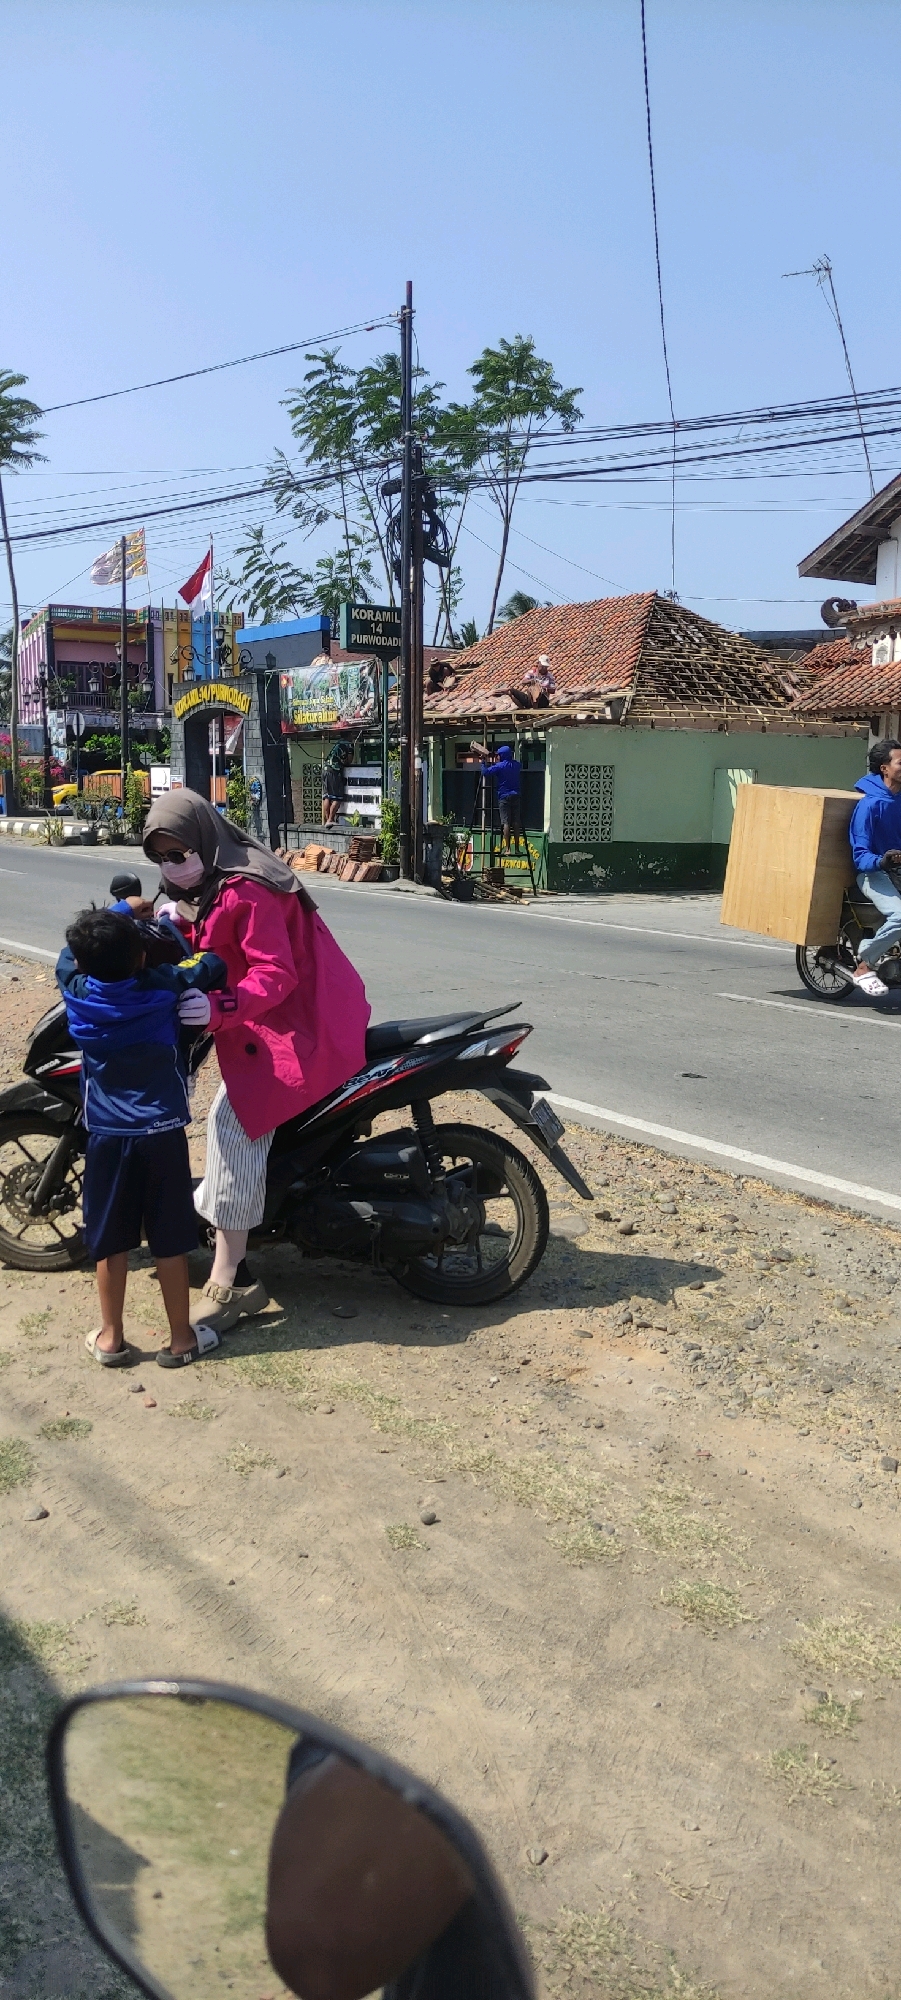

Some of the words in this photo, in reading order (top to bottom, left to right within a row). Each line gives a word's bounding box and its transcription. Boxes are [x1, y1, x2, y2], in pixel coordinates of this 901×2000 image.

[351, 608, 401, 624] KORAMIL
[370, 622, 383, 635] 14
[351, 633, 402, 647] PURWODADI
[35, 1058, 60, 1074] HONDA
